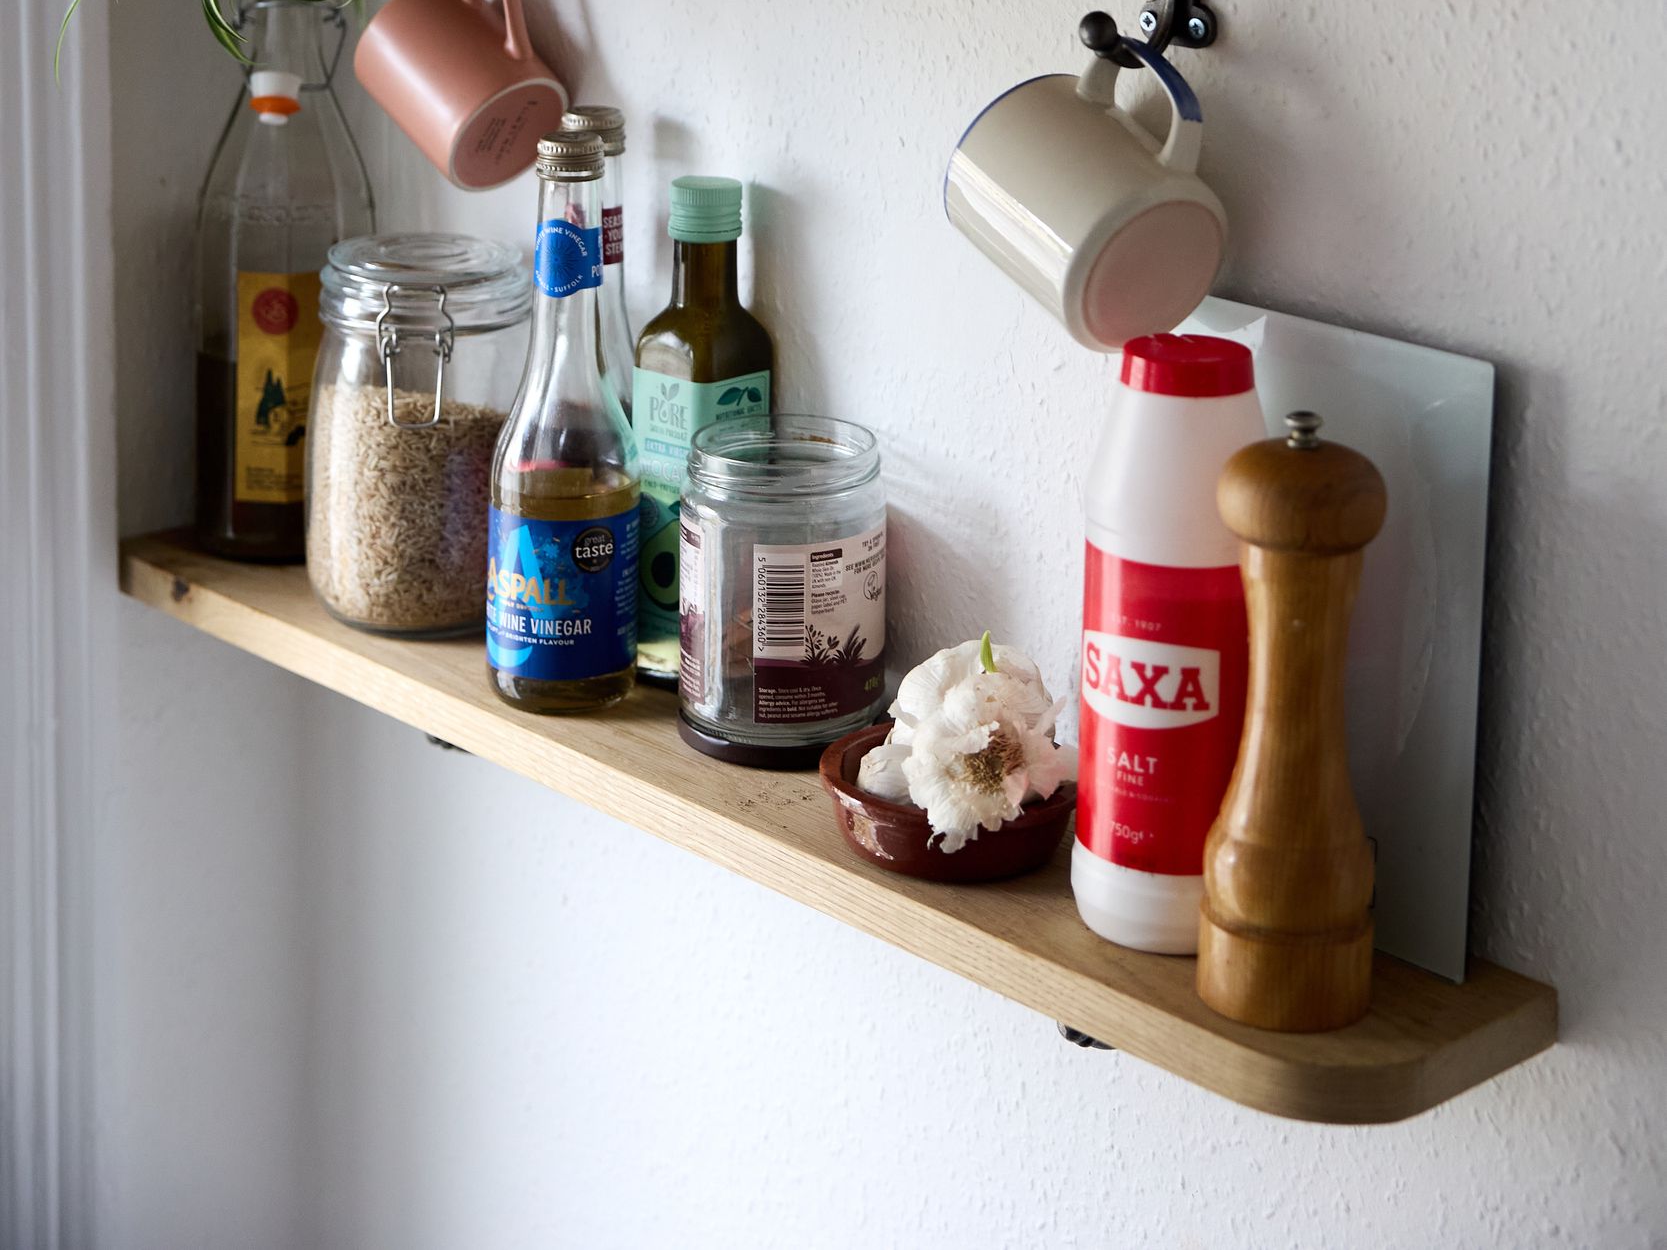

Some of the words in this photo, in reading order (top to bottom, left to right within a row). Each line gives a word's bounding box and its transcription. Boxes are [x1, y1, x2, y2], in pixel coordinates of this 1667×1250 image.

[546, 226, 563, 235] WINE
[564, 229, 588, 256] VINEGAR
[607, 230, 622, 242] YOU
[554, 274, 583, 293] SUFFOLK
[575, 542, 614, 558] taste
[584, 534, 606, 547] great
[845, 564, 854, 572] SEE
[487, 557, 576, 606] ASPALL
[757, 567, 766, 603] 060132
[500, 611, 527, 633] WINE
[530, 617, 592, 636] VINEGAR
[757, 607, 766, 643] 284360
[1134, 619, 1162, 631] 1907
[505, 631, 538, 645] BRIGHTEN
[539, 638, 575, 646] FLAVOUR
[1085, 641, 1211, 713] SAXA
[1106, 745, 1158, 775] SALT
[1116, 770, 1144, 787] FINE
